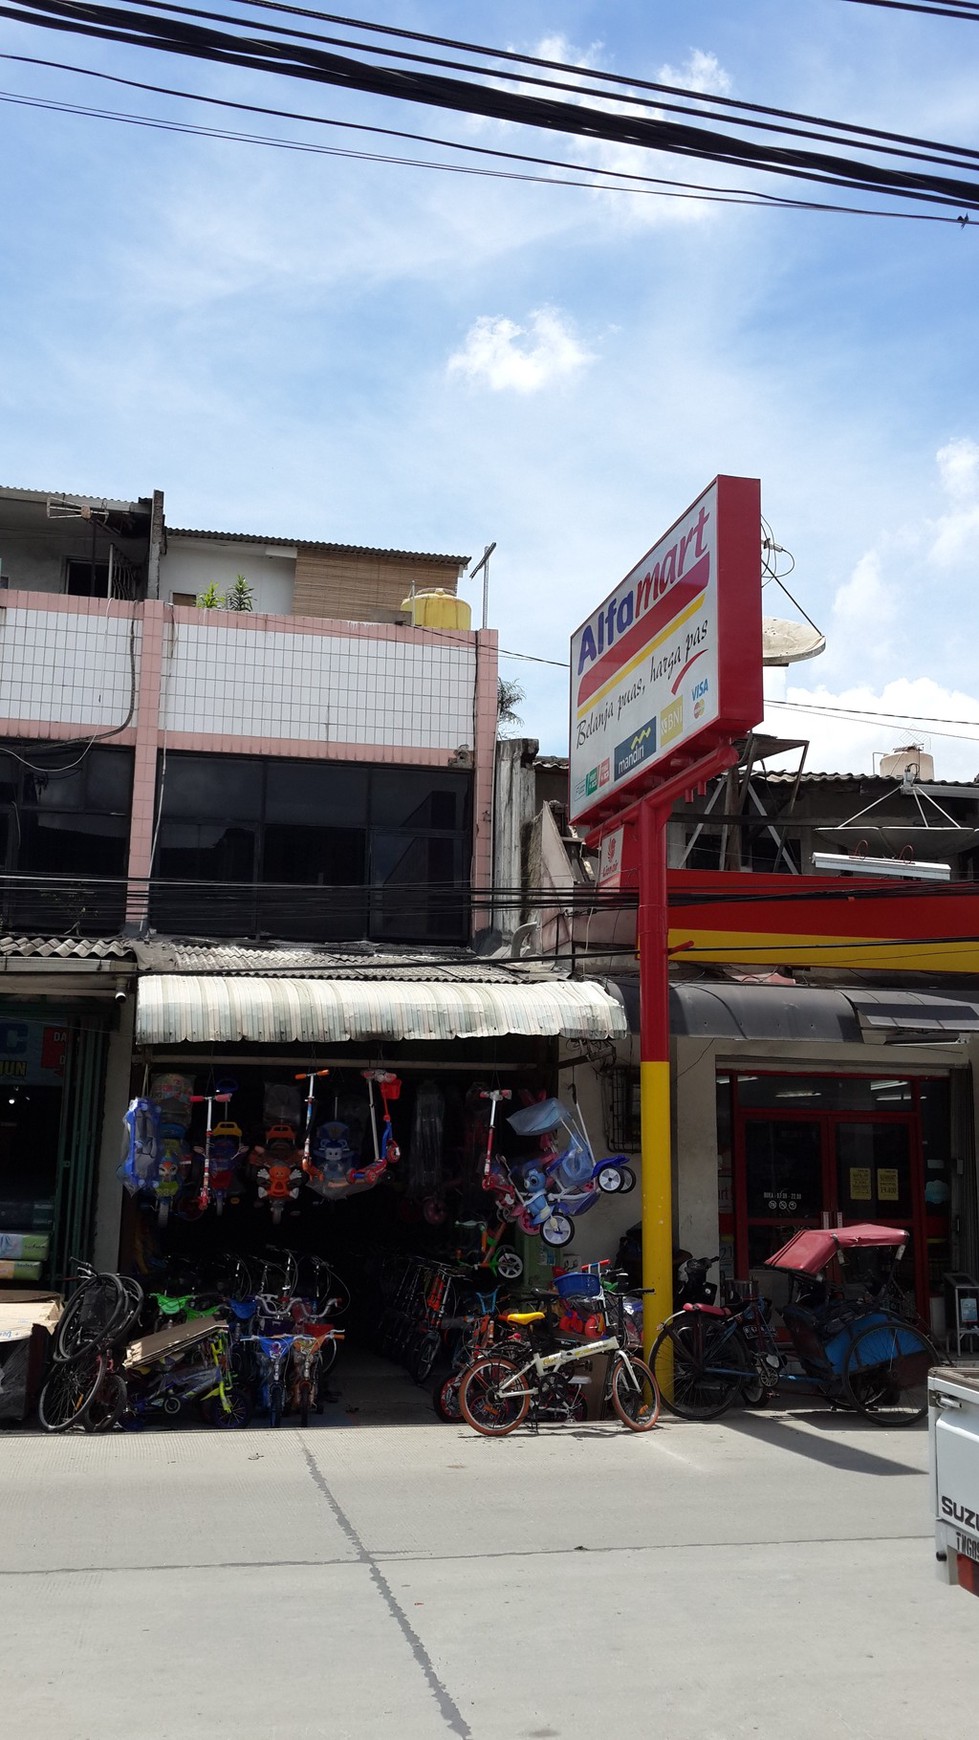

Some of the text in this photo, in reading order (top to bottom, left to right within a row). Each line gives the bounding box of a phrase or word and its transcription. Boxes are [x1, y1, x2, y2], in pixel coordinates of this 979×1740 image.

[577, 505, 710, 676] Alfamart
[576, 699, 614, 749] Belanja
[650, 645, 682, 683] harga
[685, 619, 708, 663] pas
[667, 706, 683, 730] BNI
[691, 678, 709, 701] VISA
